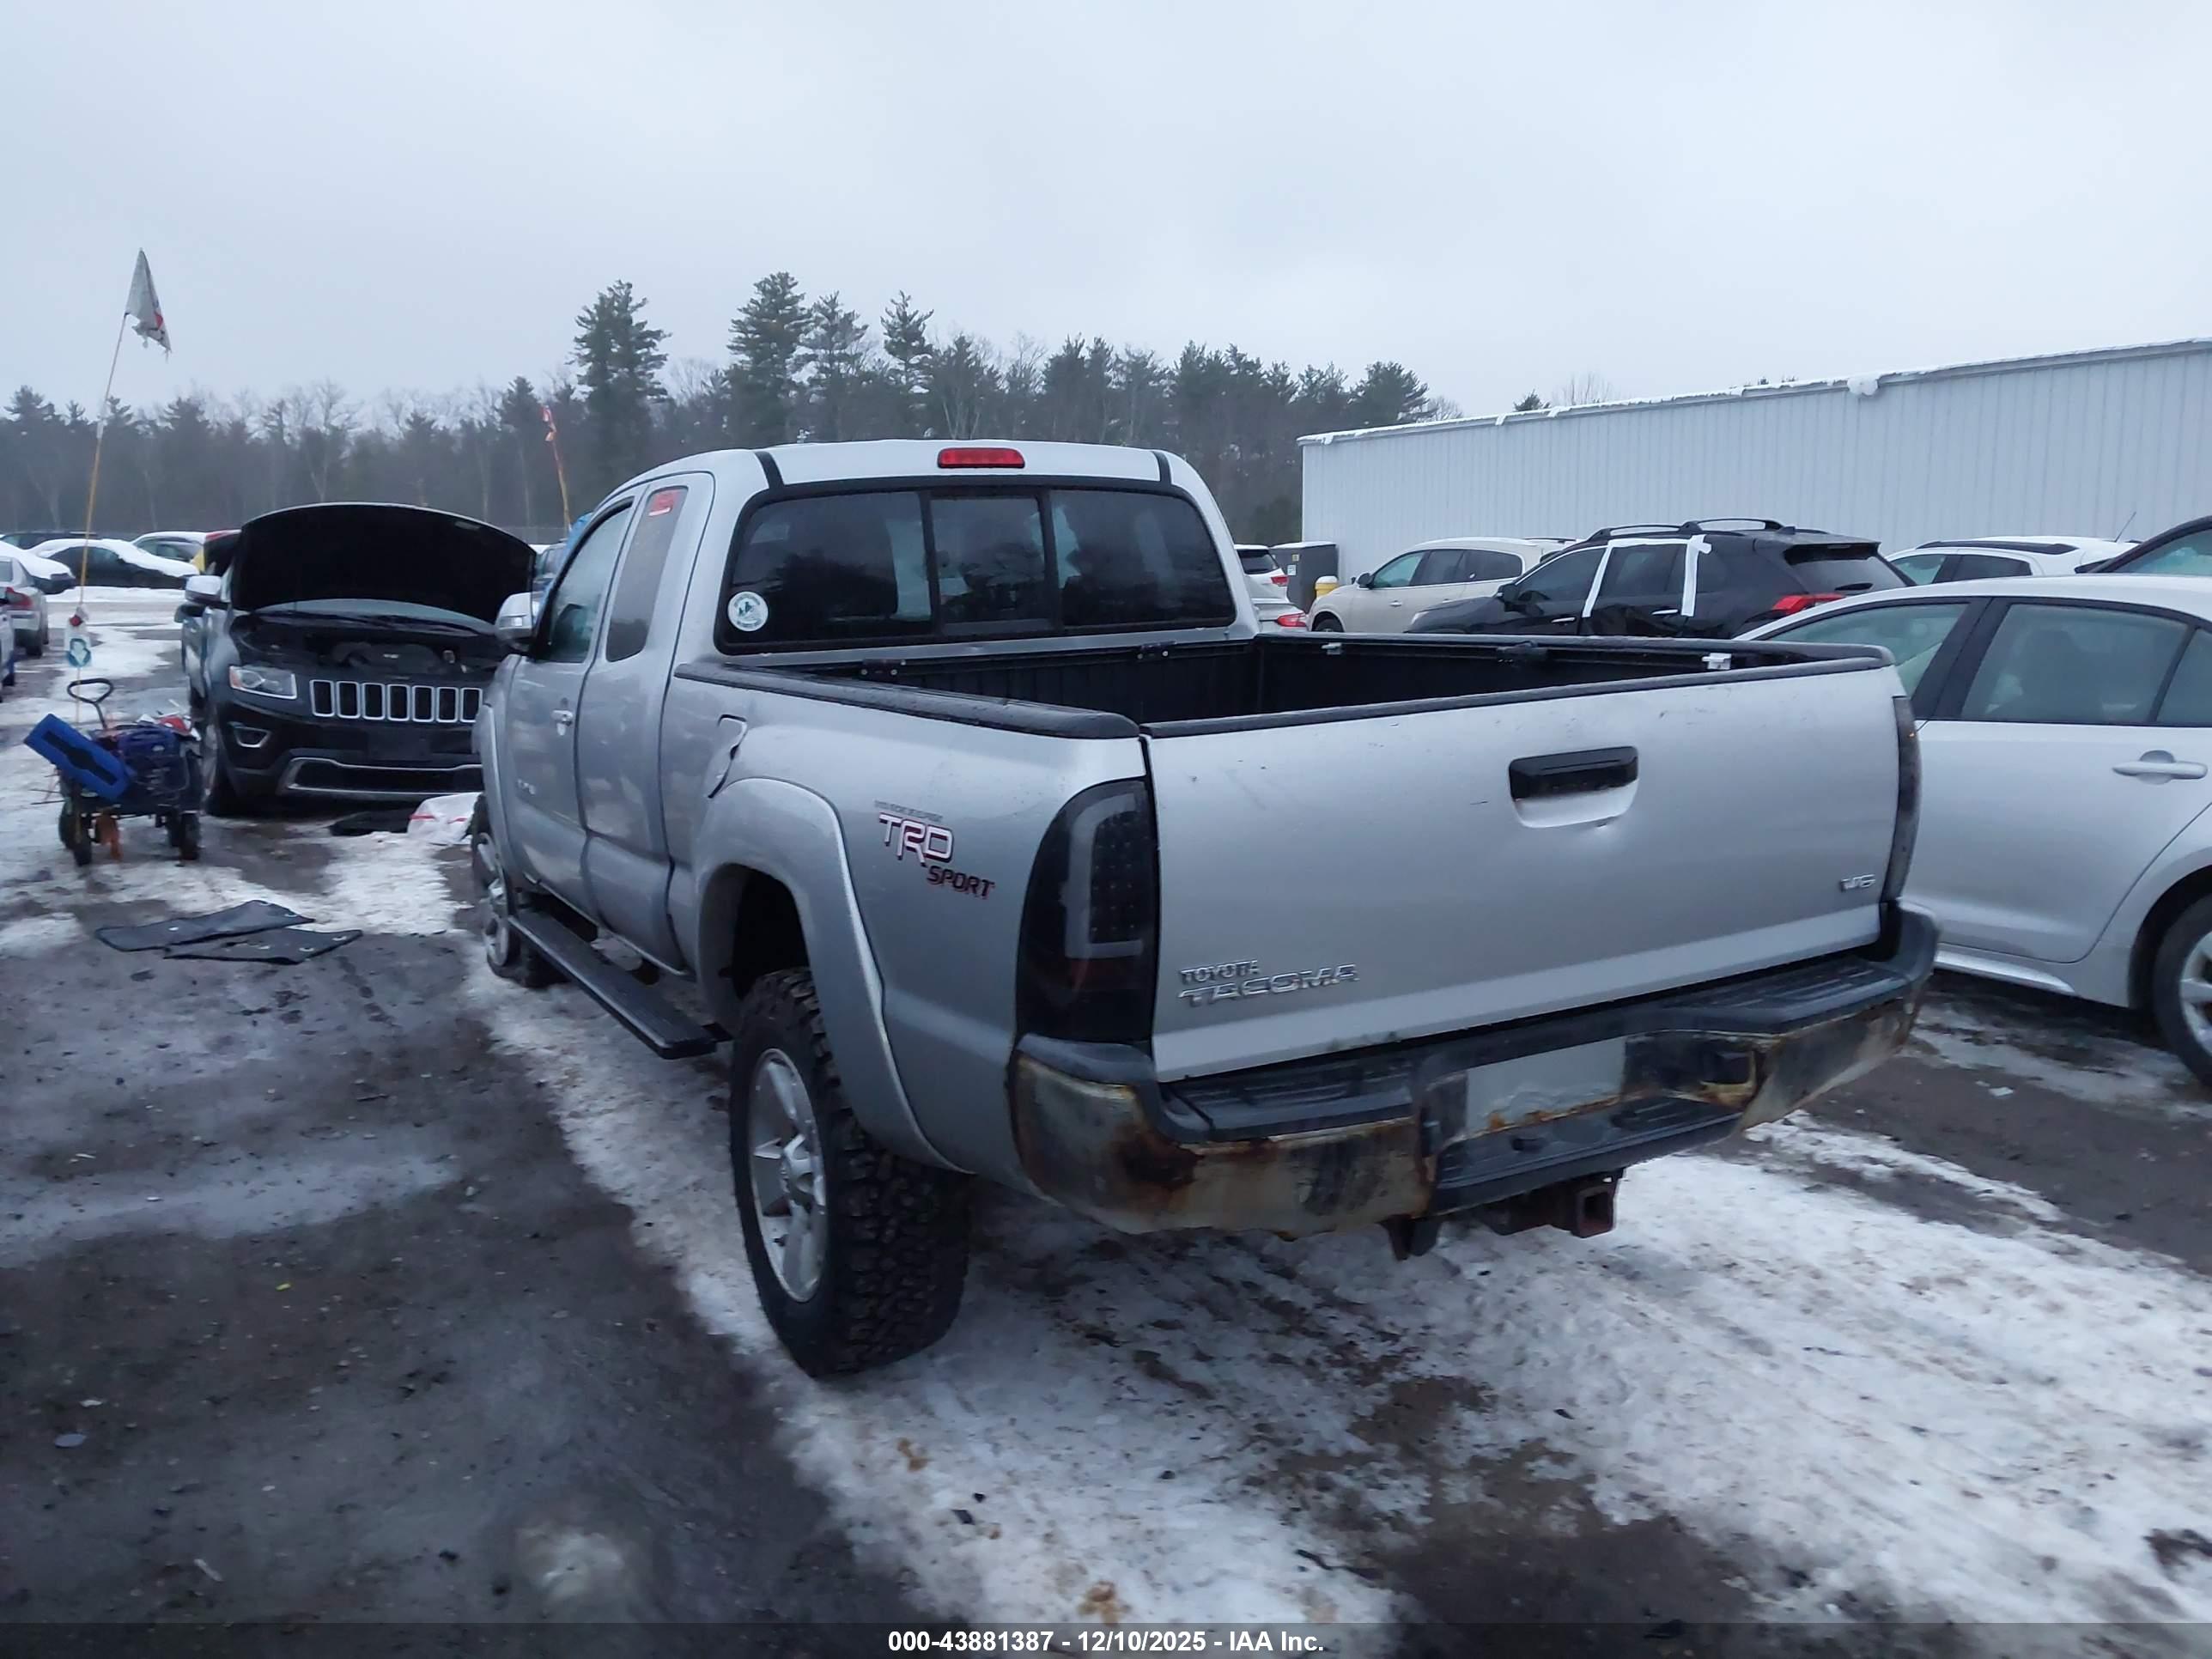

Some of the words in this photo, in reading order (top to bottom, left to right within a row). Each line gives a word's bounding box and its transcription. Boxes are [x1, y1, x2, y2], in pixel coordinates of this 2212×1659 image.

[878, 811, 955, 867] TRD
[927, 865, 996, 900] SPORT
[1177, 963, 1361, 1008] TACOMA
